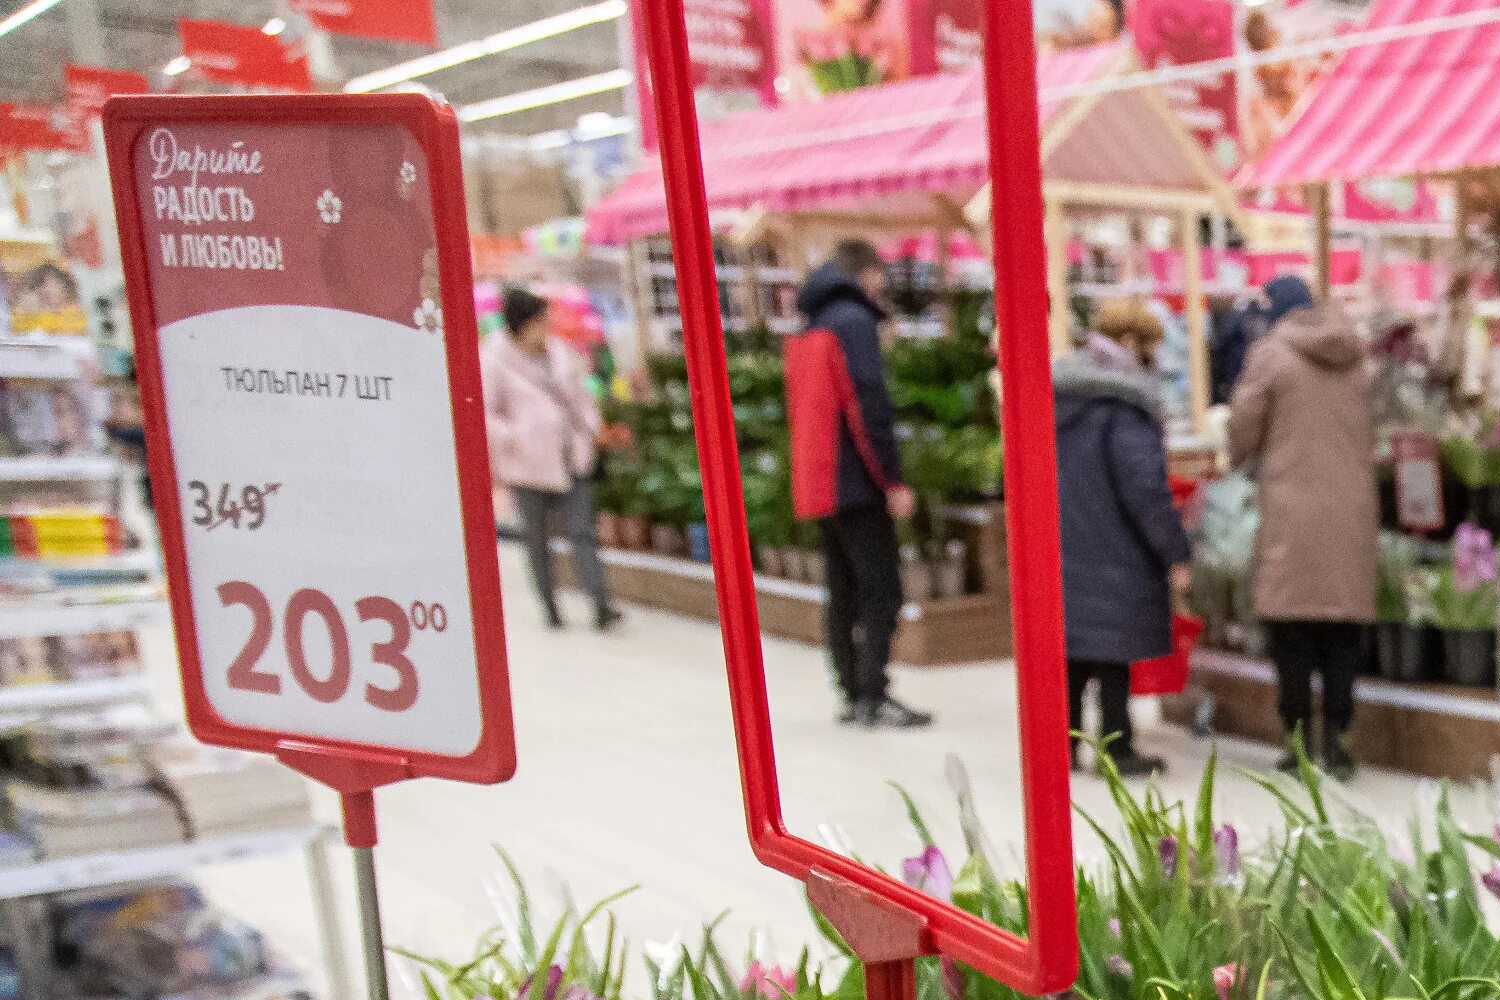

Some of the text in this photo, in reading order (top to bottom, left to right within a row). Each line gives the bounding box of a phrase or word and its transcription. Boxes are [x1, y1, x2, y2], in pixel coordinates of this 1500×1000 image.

[150, 128, 264, 187] Дарите
[153, 185, 255, 226] РАДОСТЬ
[160, 233, 285, 271] И ЛЮБОВЬ!
[220, 367, 393, 401] ТЮЛЬПАН 7 ШТ
[215, 579, 448, 714] 203 00
